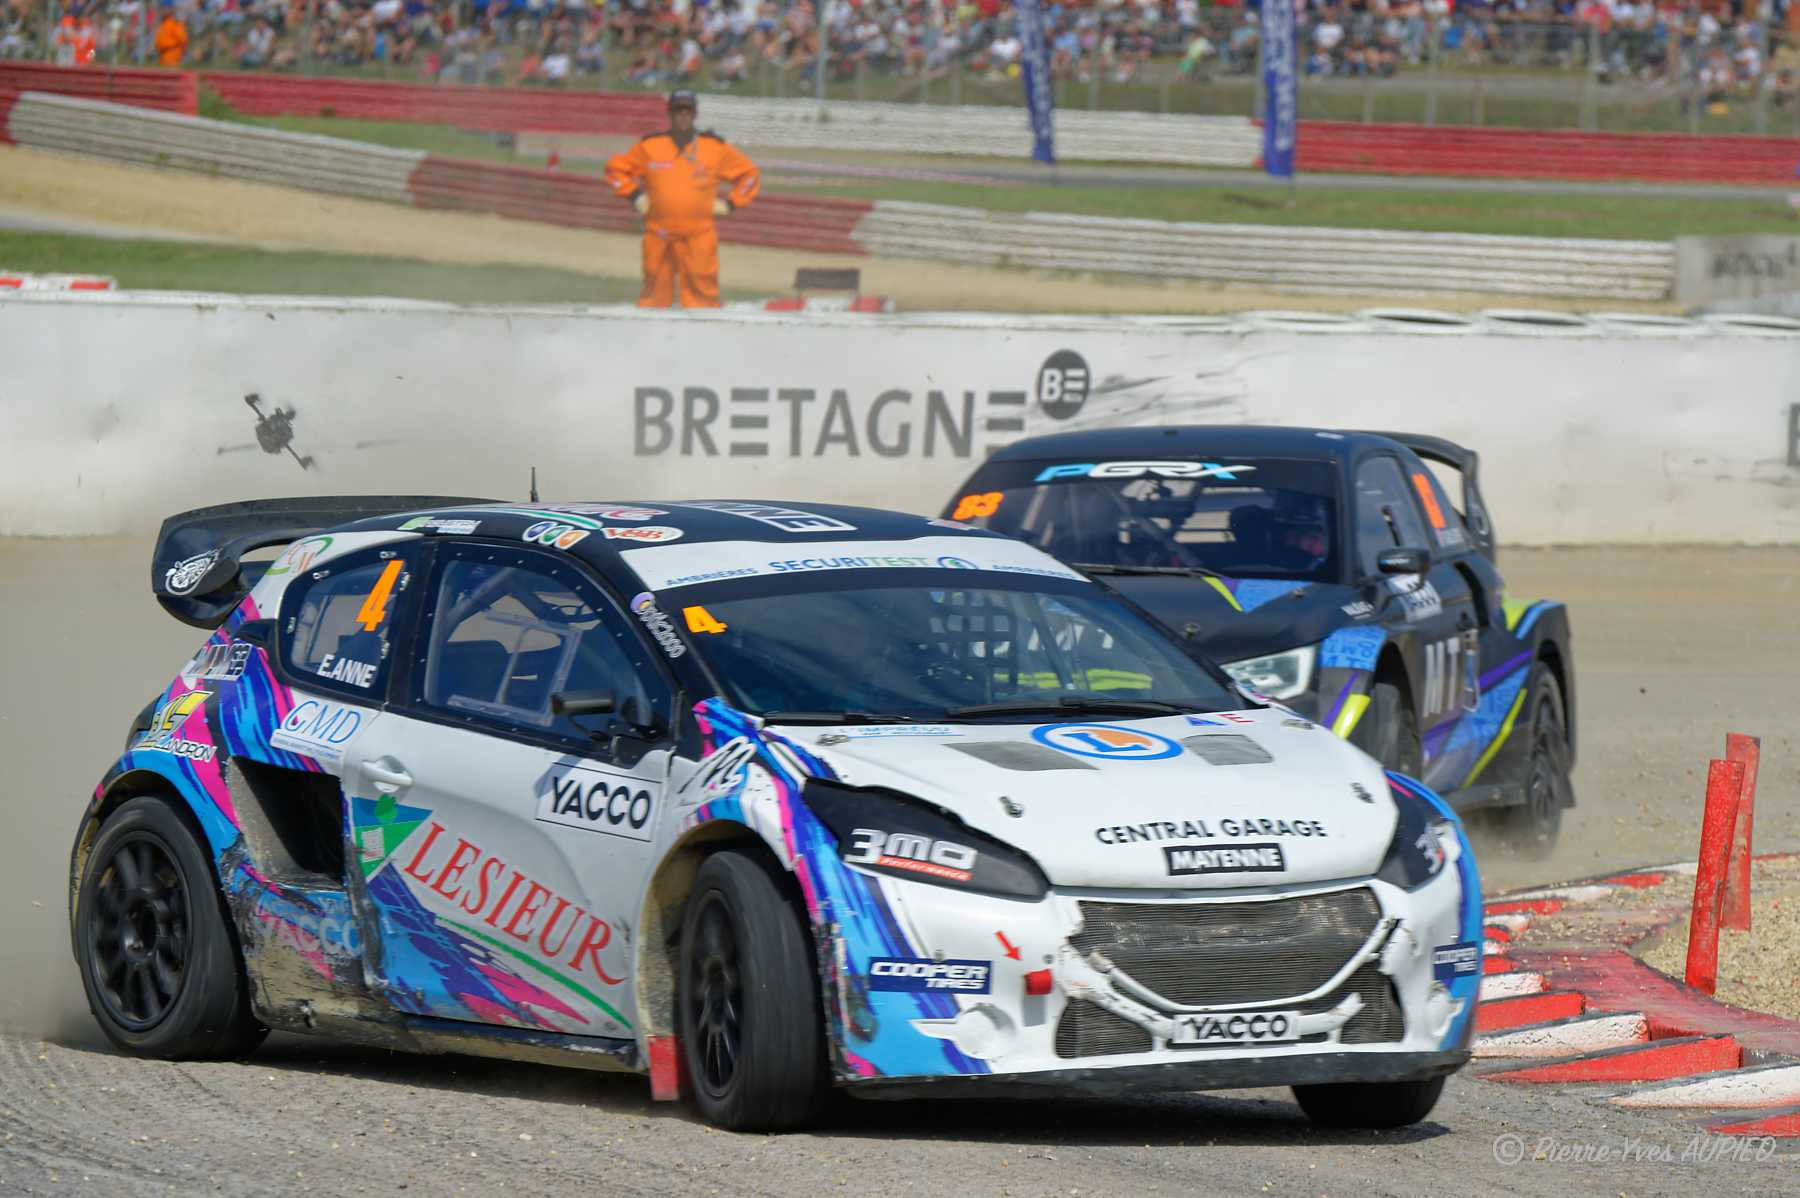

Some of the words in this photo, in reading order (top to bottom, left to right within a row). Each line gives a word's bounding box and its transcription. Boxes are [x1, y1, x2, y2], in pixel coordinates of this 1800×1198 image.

[1041, 368, 1085, 402] BE
[633, 387, 1027, 458] BRETAGNE
[1034, 460, 1257, 482] PGRX
[767, 556, 930, 572] SECURITEST
[354, 559, 404, 632] 4
[682, 606, 728, 635] 4
[316, 653, 377, 689] E.ANNE
[284, 700, 362, 744] CMD
[551, 776, 651, 830] YACCO
[1095, 819, 1216, 845] CENTRAL
[1220, 818, 1328, 838] GARAGE
[1170, 848, 1282, 870] MAYENNE
[403, 822, 631, 985] LESIEUR
[870, 961, 989, 979] COOPER
[925, 978, 985, 990] TIRES
[1182, 1014, 1289, 1040] YACCO
